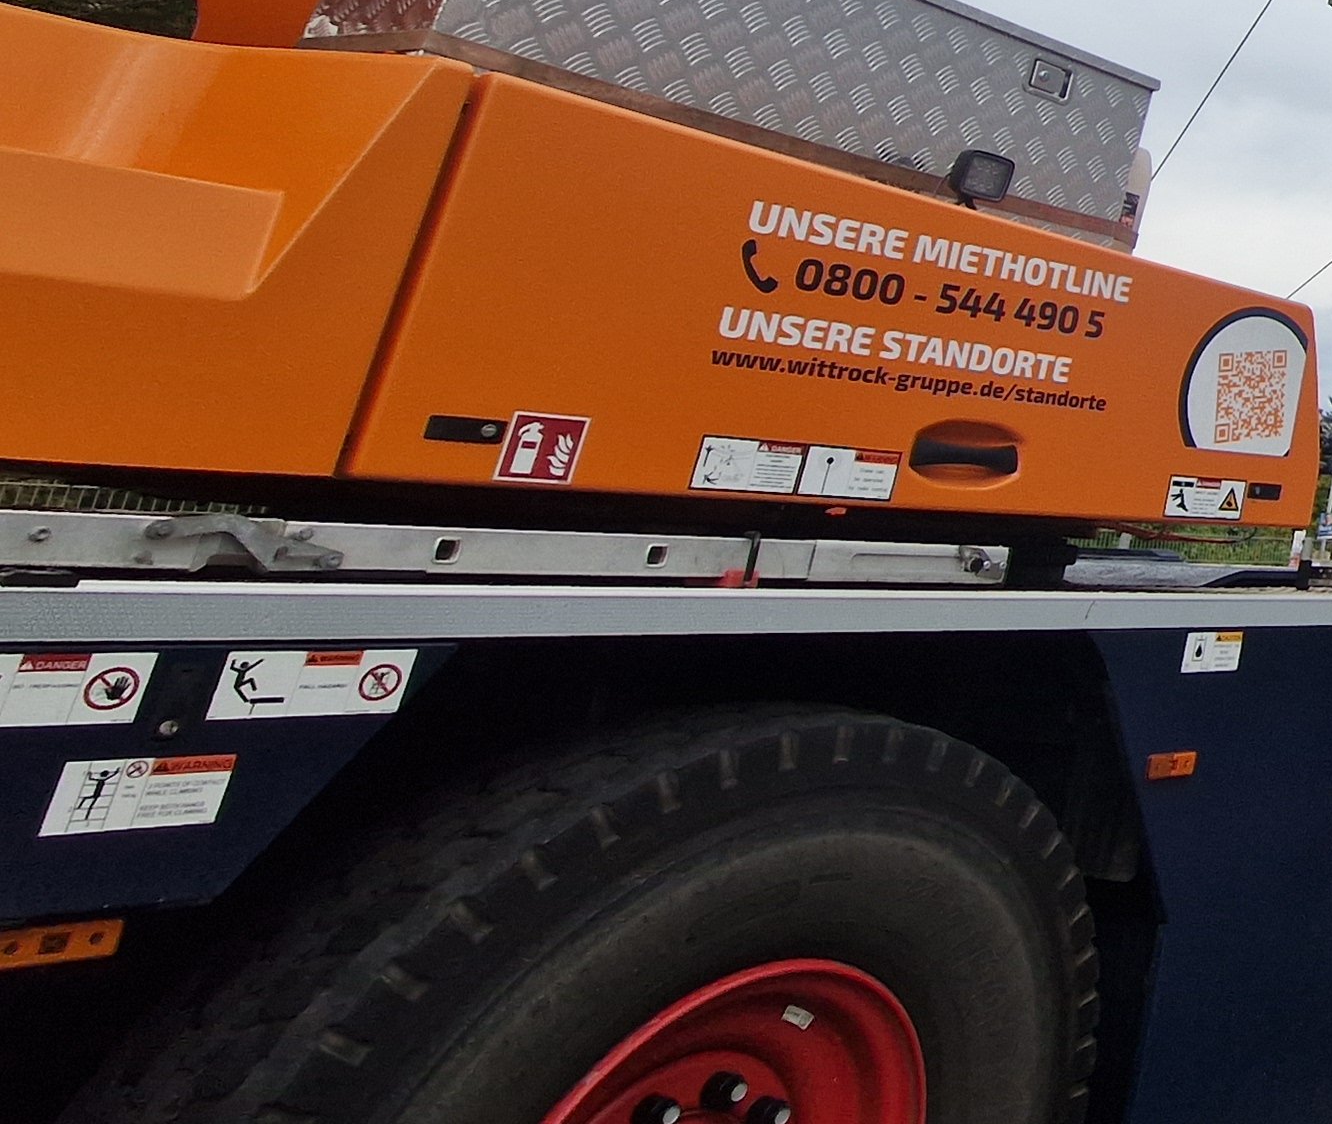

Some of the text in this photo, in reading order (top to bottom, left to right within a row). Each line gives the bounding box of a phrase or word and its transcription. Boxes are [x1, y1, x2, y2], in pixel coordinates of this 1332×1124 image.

[748, 199, 1133, 303] UNSERE MIETHOTLINE
[794, 258, 906, 306] 0800
[934, 284, 1007, 323] 544
[1013, 297, 1081, 335] 490
[1085, 310, 1106, 339] 5
[718, 306, 1074, 384] UNSERE STANDORTE
[710, 349, 1108, 412] www.wittrock-gruppe.de/standorte
[35, 659, 88, 671] DANGER
[169, 758, 233, 771] WARNING
